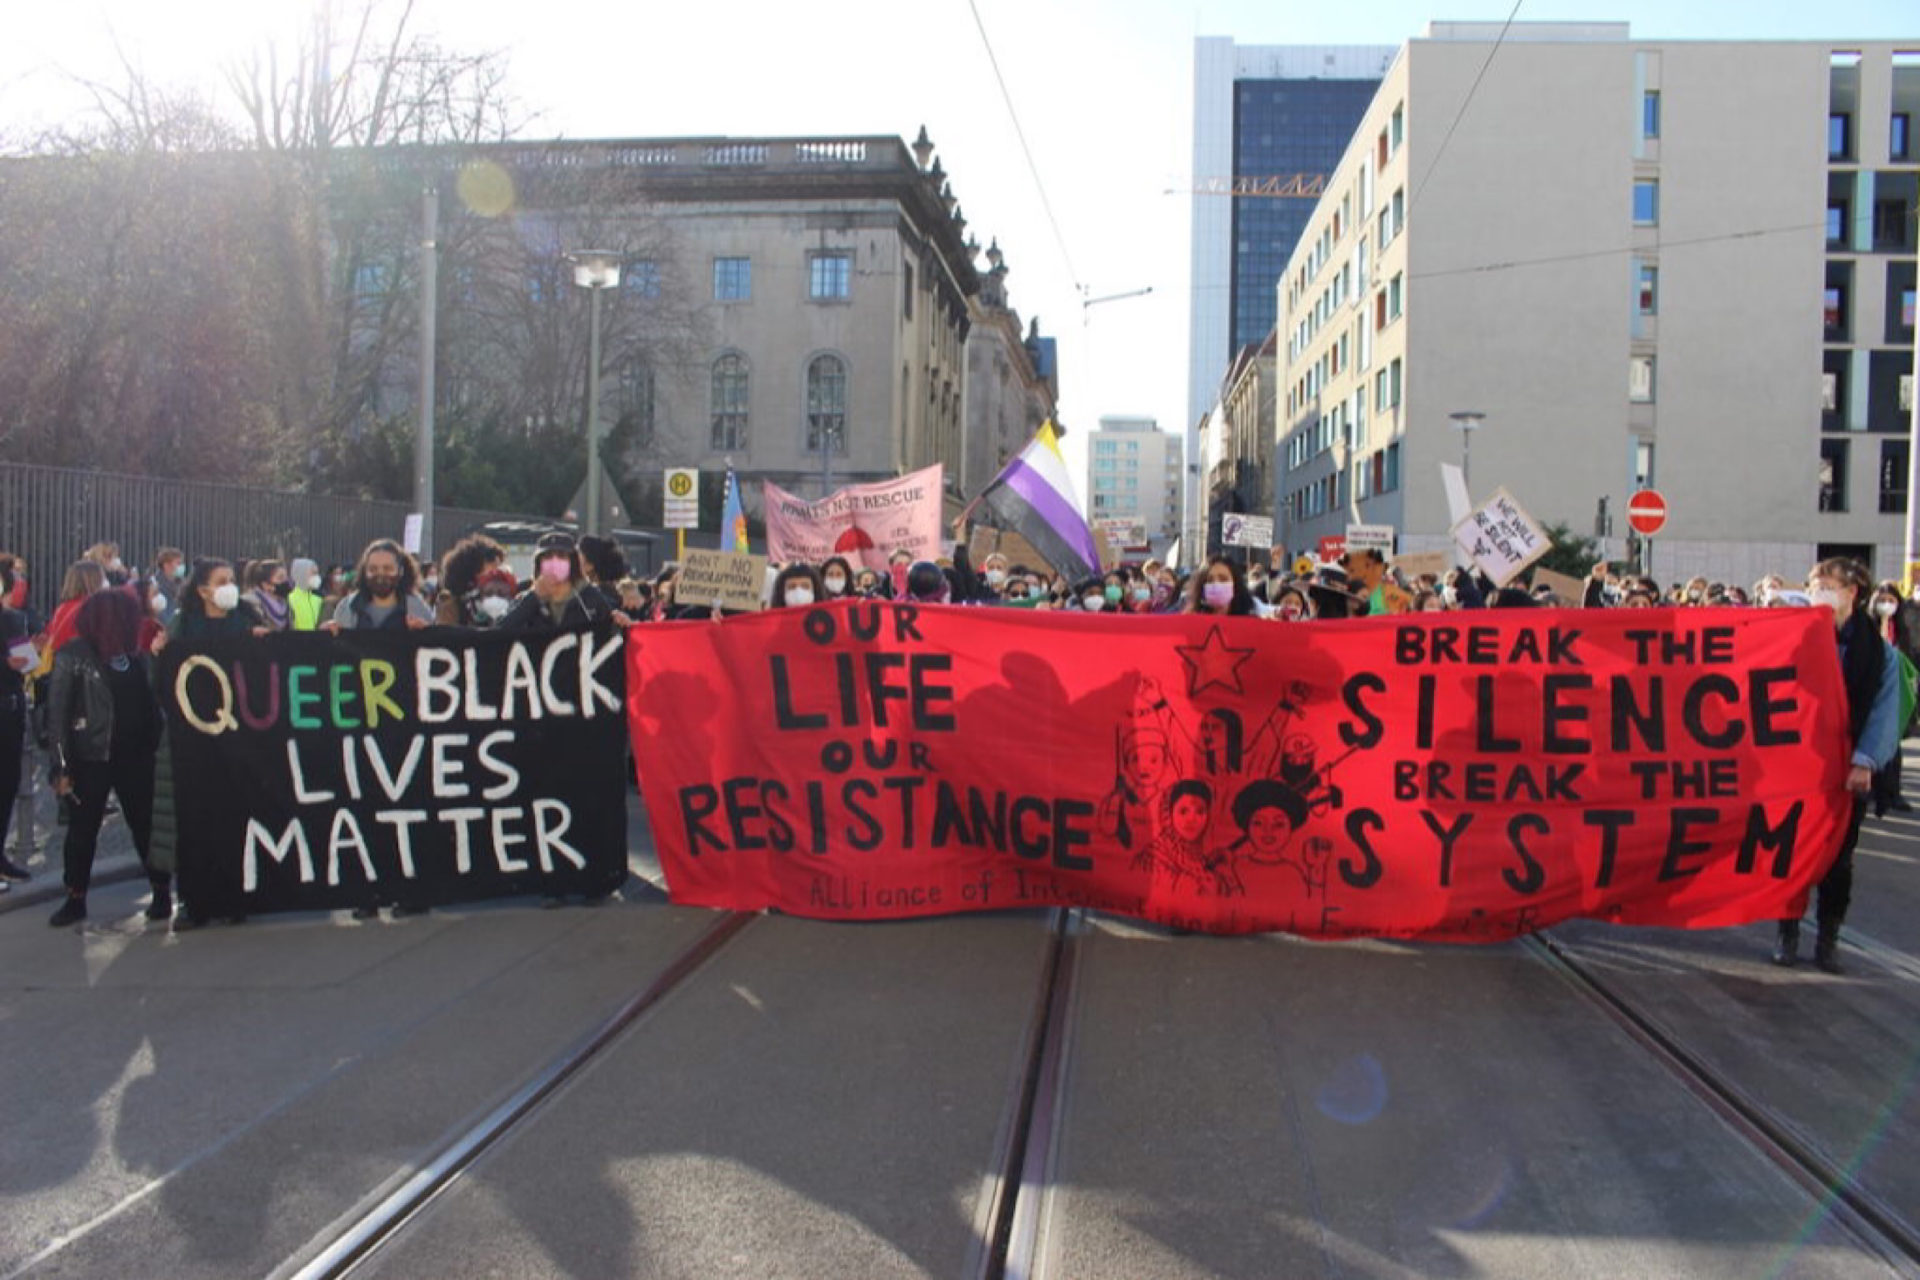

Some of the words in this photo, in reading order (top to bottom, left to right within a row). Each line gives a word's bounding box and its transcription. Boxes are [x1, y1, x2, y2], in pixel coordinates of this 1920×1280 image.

[833, 495, 859, 513] NOT
[864, 488, 924, 509] RESCUE
[1497, 498, 1517, 519] WE
[1512, 516, 1536, 548] WILL
[731, 558, 752, 574] NO
[1484, 525, 1523, 563] SILENT
[804, 605, 923, 644] OUR
[1395, 626, 1584, 666] BREAK
[1625, 627, 1736, 665] THE
[175, 654, 405, 735] QUEER
[416, 632, 624, 723] BLACK
[770, 652, 956, 731] LIFE
[1337, 667, 1802, 755] SILENCE
[287, 730, 520, 804] LIVES
[820, 738, 937, 773] OUR
[1394, 760, 1586, 801] BREAK
[1629, 759, 1739, 799] THE
[243, 799, 587, 892] MATTER
[679, 777, 1096, 872] RESISTANCE
[1337, 800, 1805, 894] SYSTEM
[961, 869, 995, 904] of
